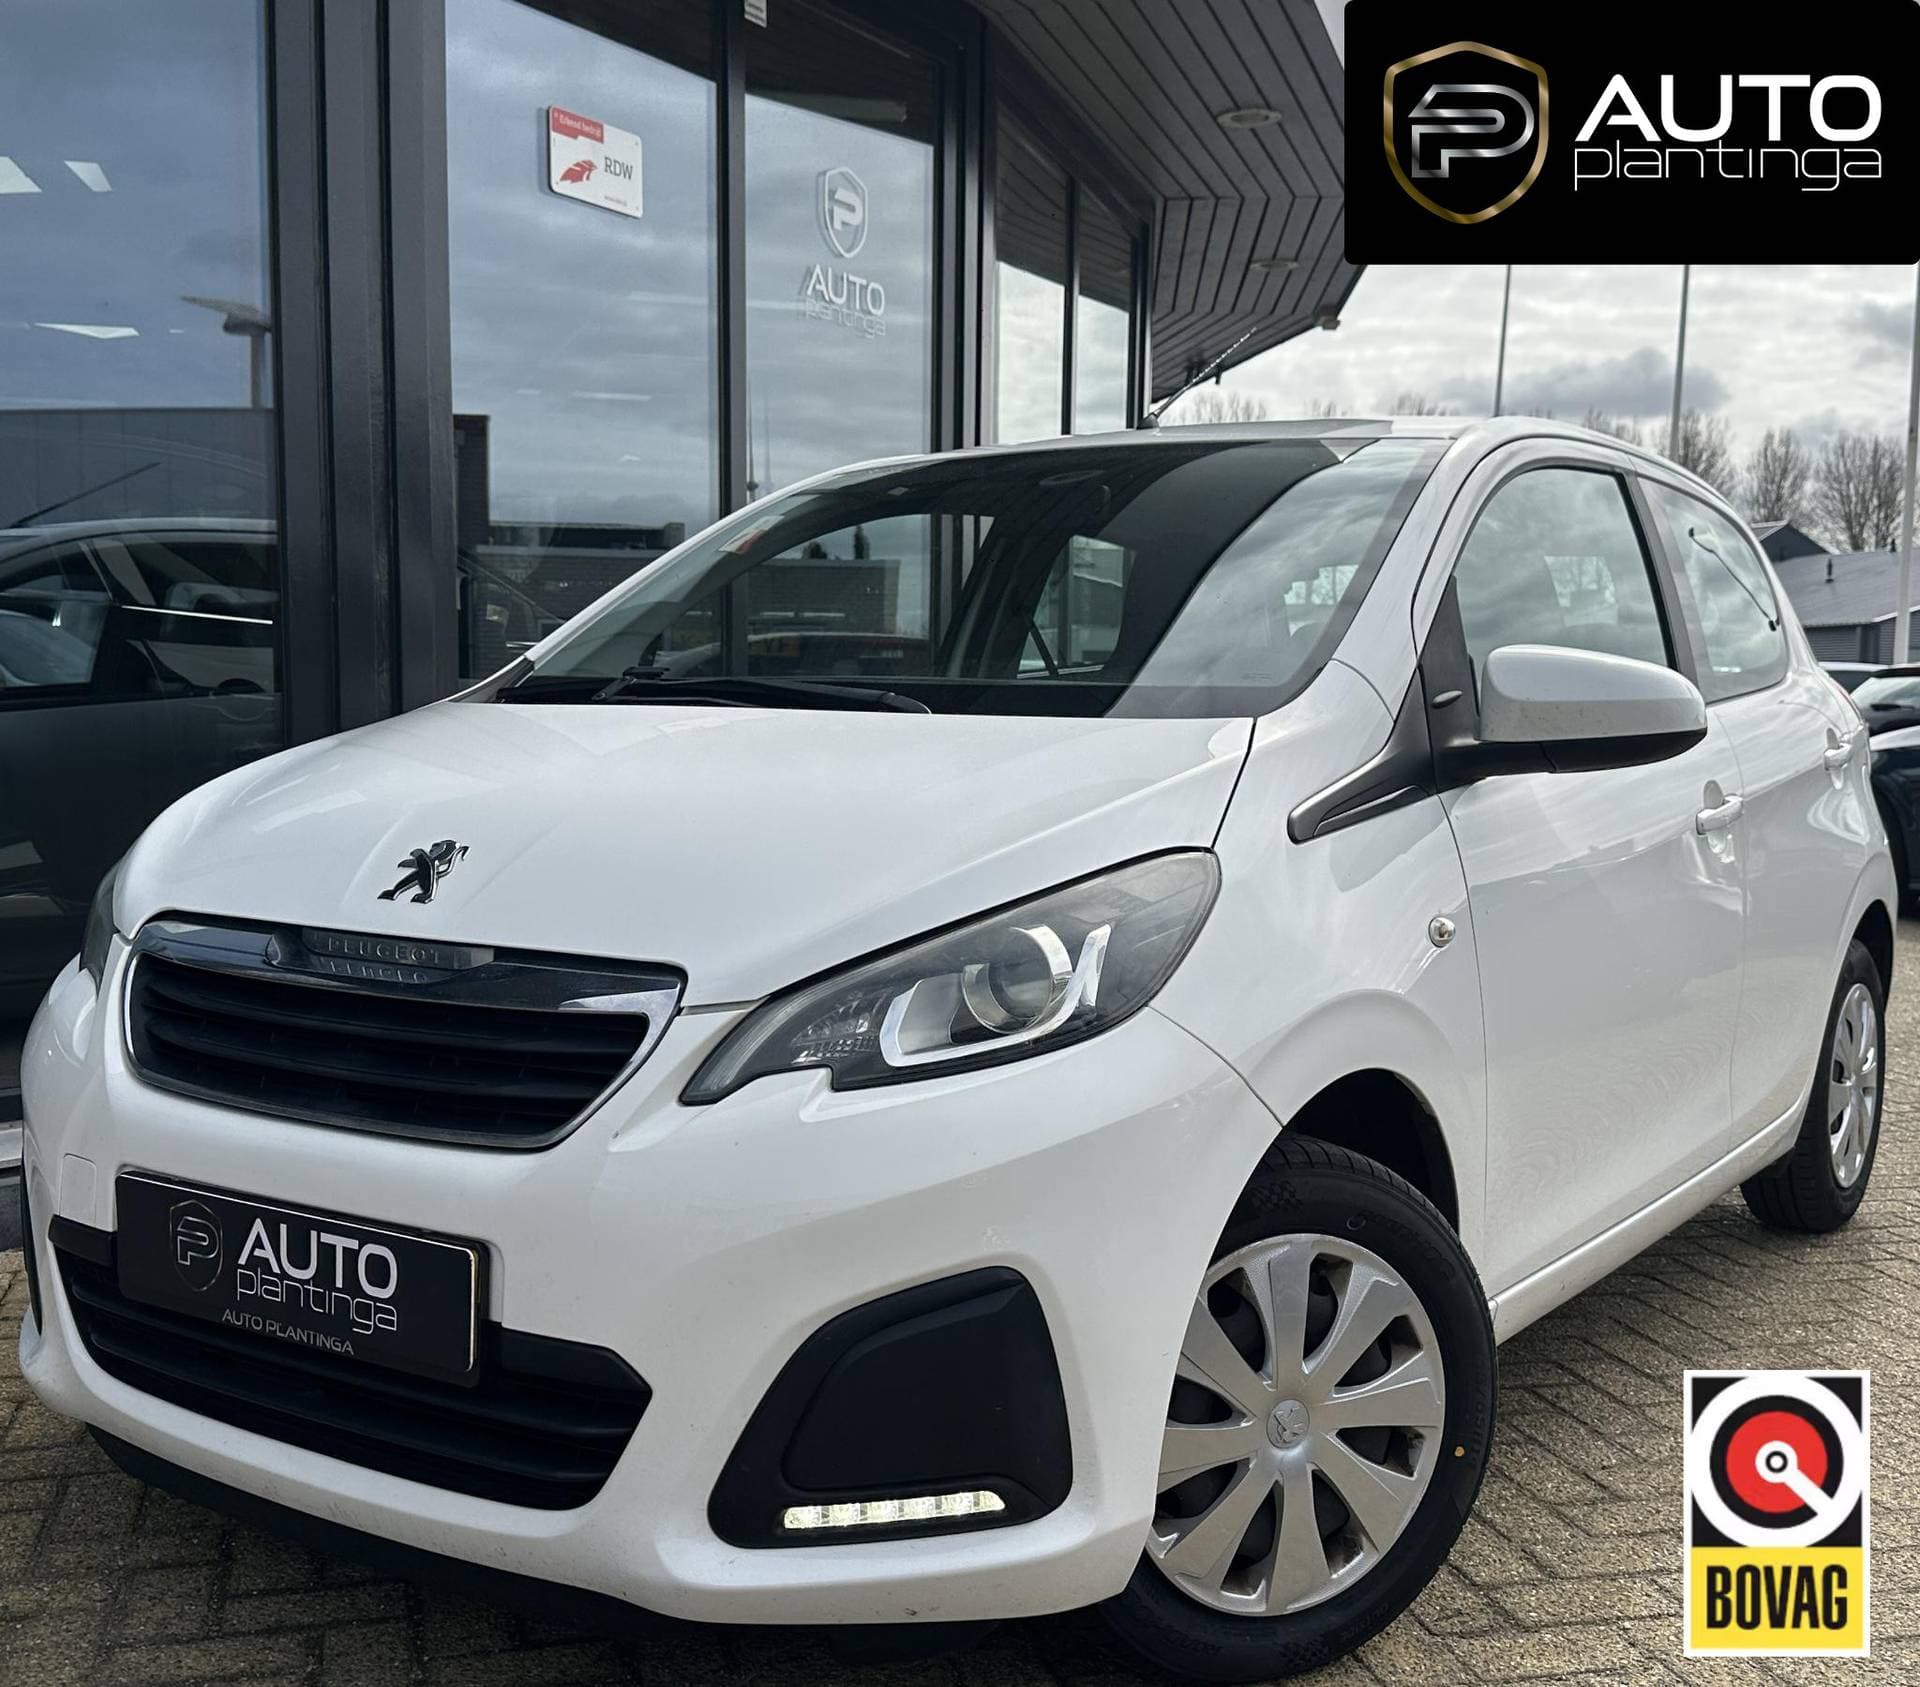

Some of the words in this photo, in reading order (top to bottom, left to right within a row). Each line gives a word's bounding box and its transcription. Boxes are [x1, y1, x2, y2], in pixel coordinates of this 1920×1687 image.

[603, 156, 634, 181] RDW
[806, 264, 885, 316] AUTO
[328, 936, 440, 964] PEUGEOT
[237, 1217, 398, 1299] AUTO
[236, 1267, 398, 1335] plantinga
[222, 1308, 263, 1332] AUTO
[266, 1320, 355, 1356] PLANTINGA
